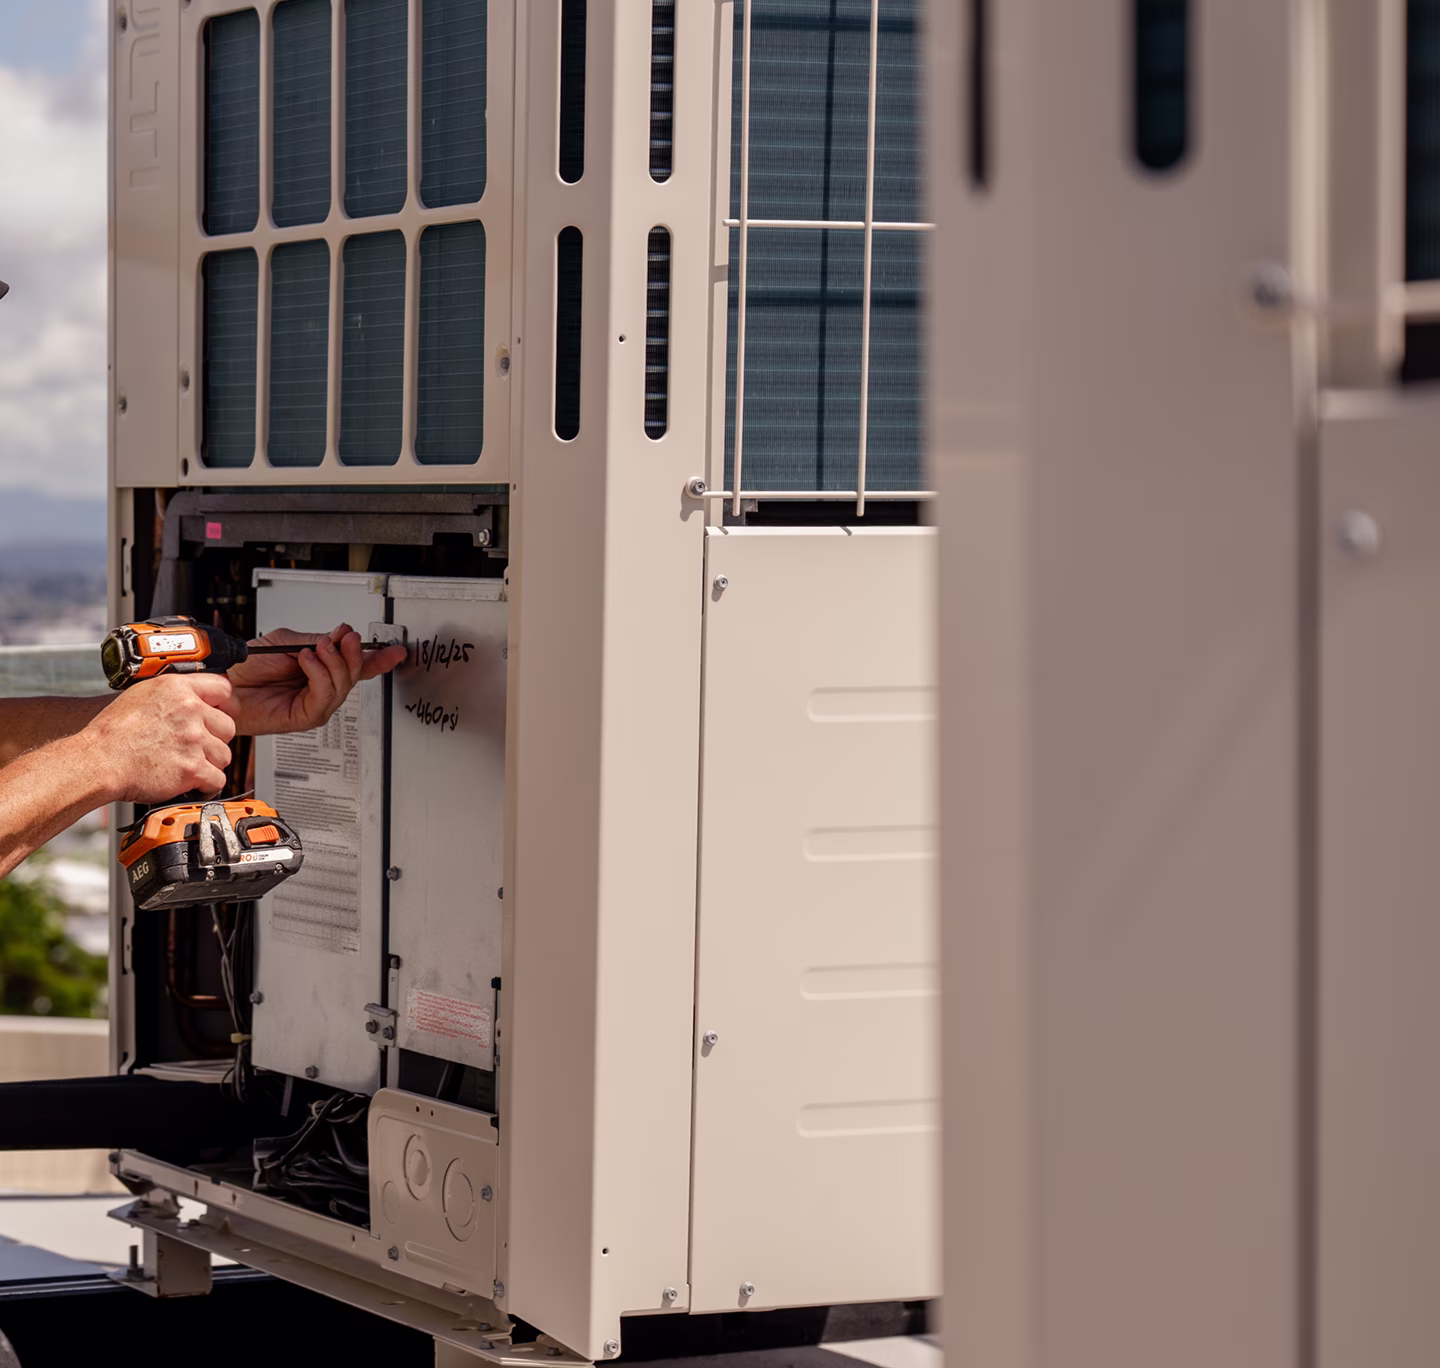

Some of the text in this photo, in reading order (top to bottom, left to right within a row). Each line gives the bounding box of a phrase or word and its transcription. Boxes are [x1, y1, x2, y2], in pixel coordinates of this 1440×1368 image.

[415, 634, 475, 672] 18/12/25
[239, 854, 252, 862] RO
[132, 861, 150, 884] AEG
